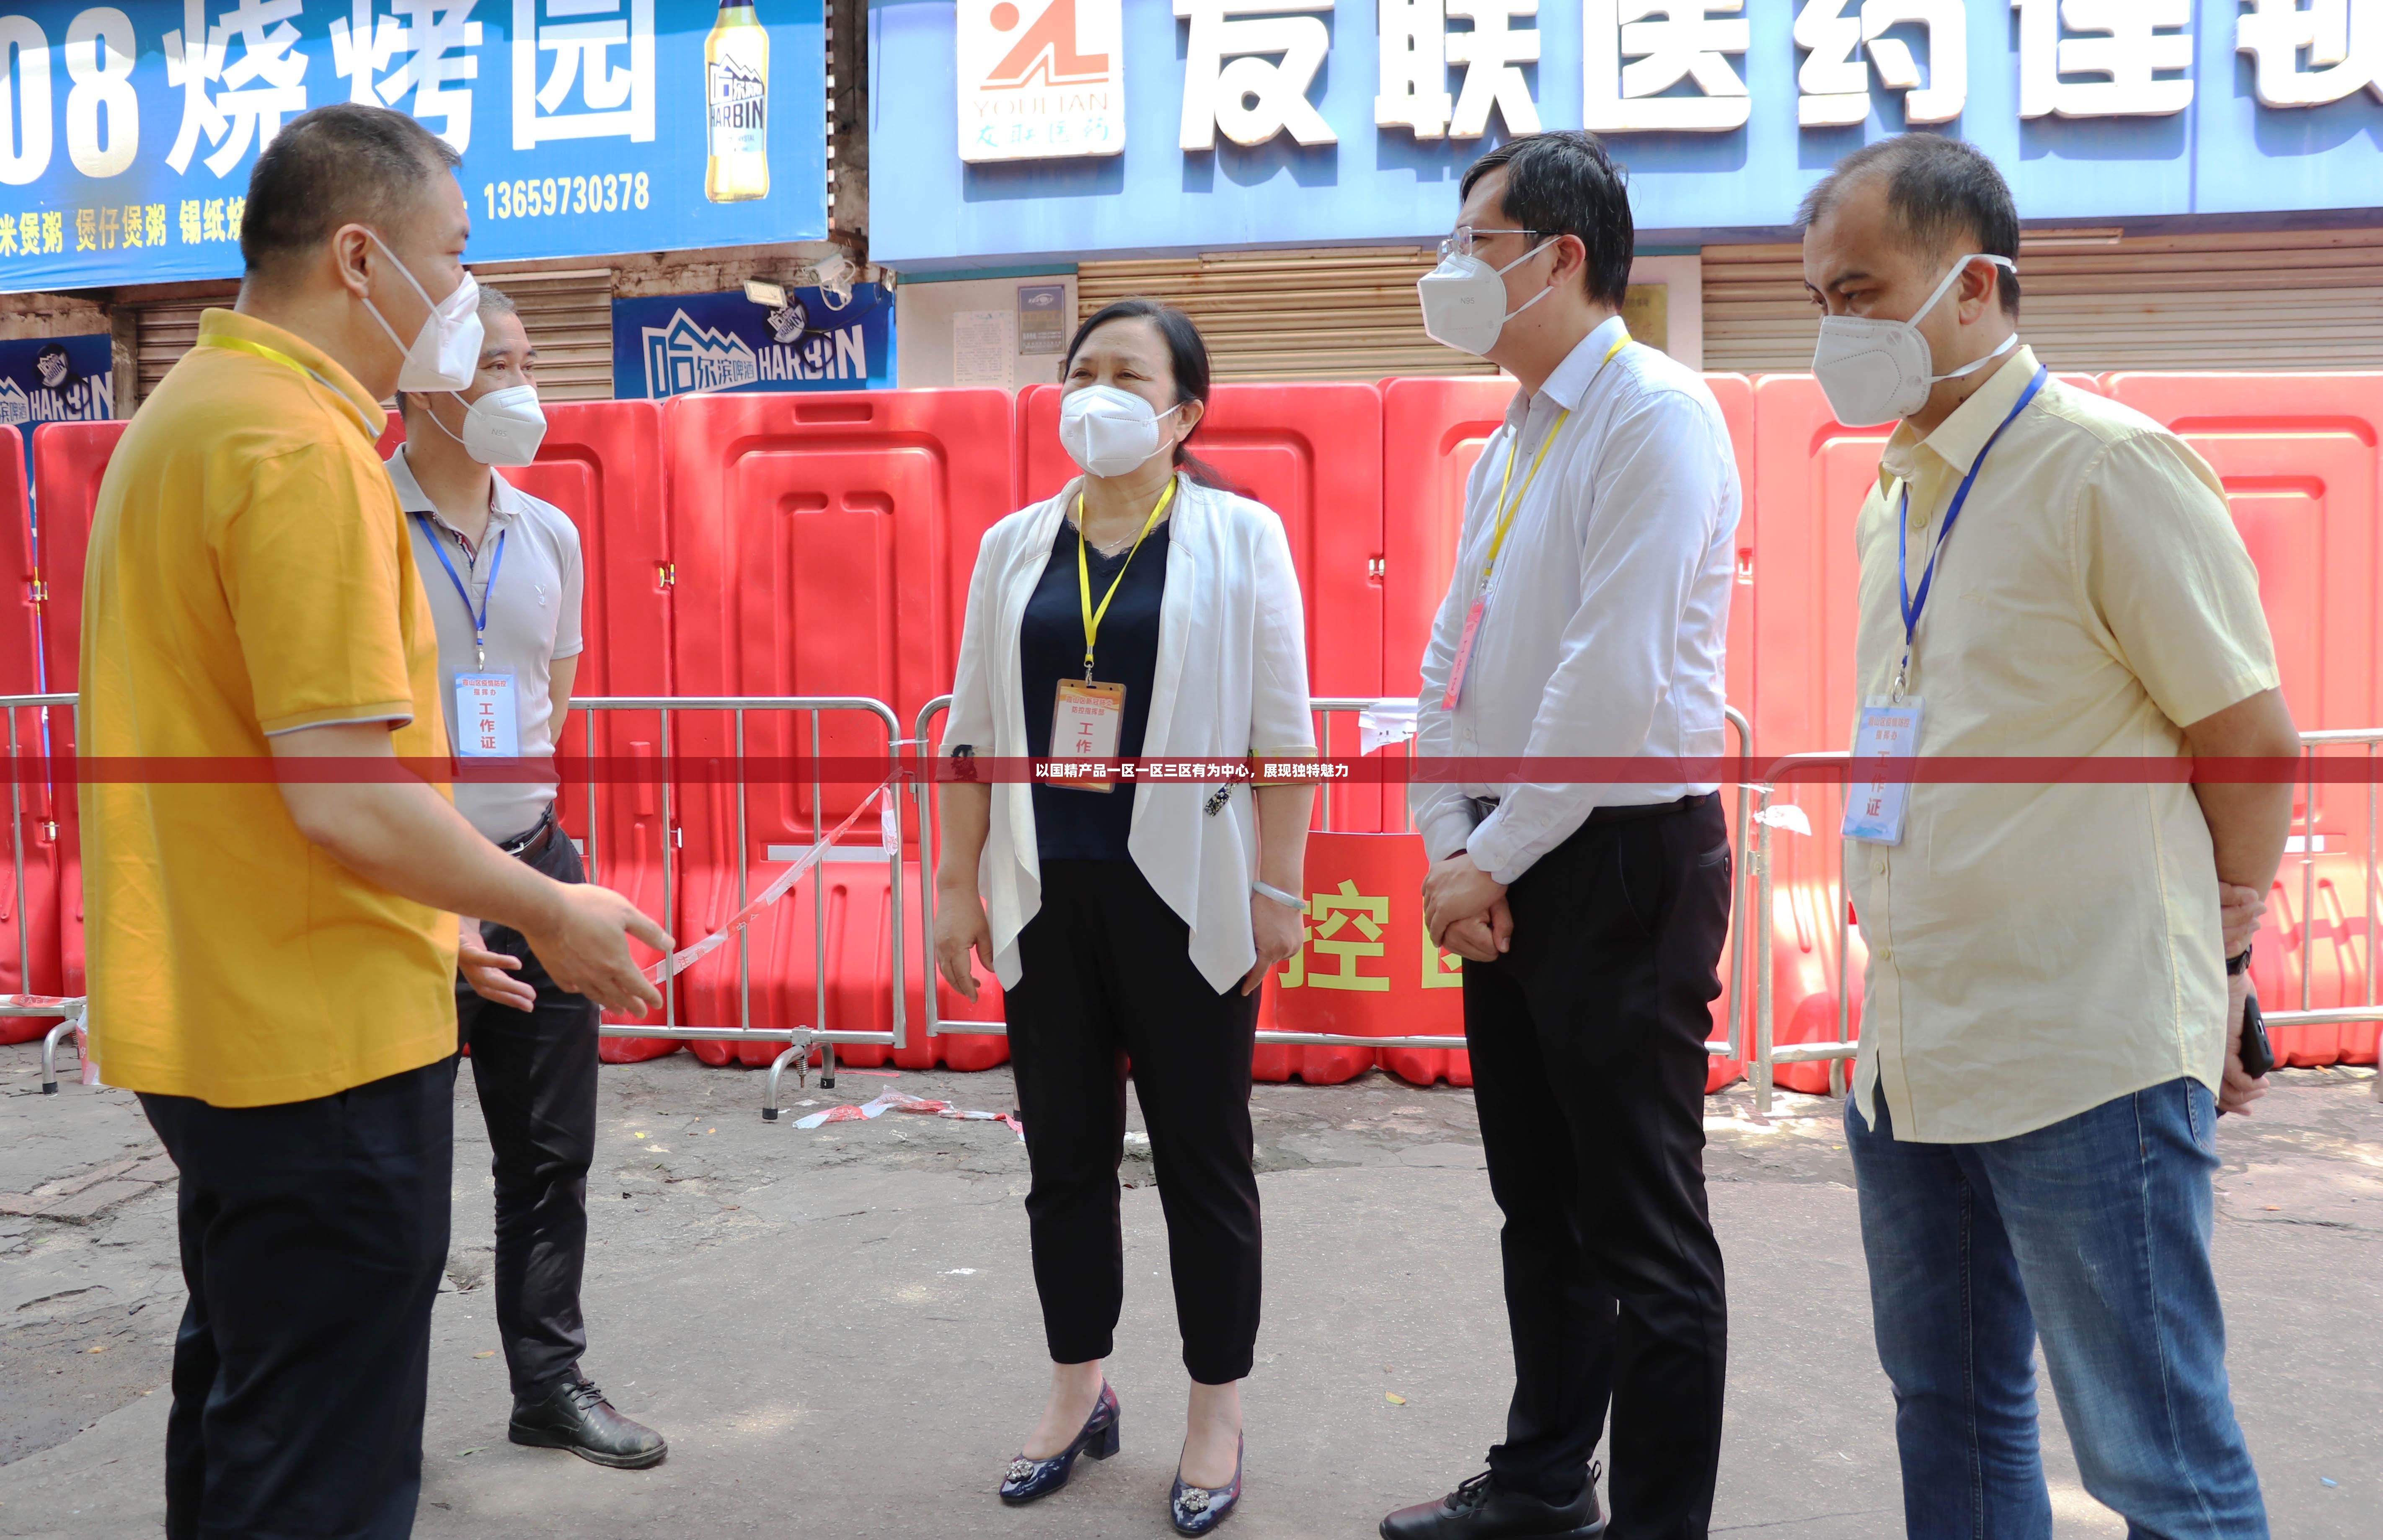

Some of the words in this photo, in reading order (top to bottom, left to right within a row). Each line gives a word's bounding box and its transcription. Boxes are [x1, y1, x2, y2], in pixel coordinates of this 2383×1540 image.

[711, 98, 763, 129] HARBIN
[484, 172, 649, 220] 13659730378
[75, 203, 166, 251] 煲仔煲粥
[758, 324, 867, 380] HARBIN
[30, 371, 114, 420] HARBIN
[491, 429, 507, 437] N95
[479, 703, 496, 749] 工作证
[1866, 751, 1890, 816] 工作证
